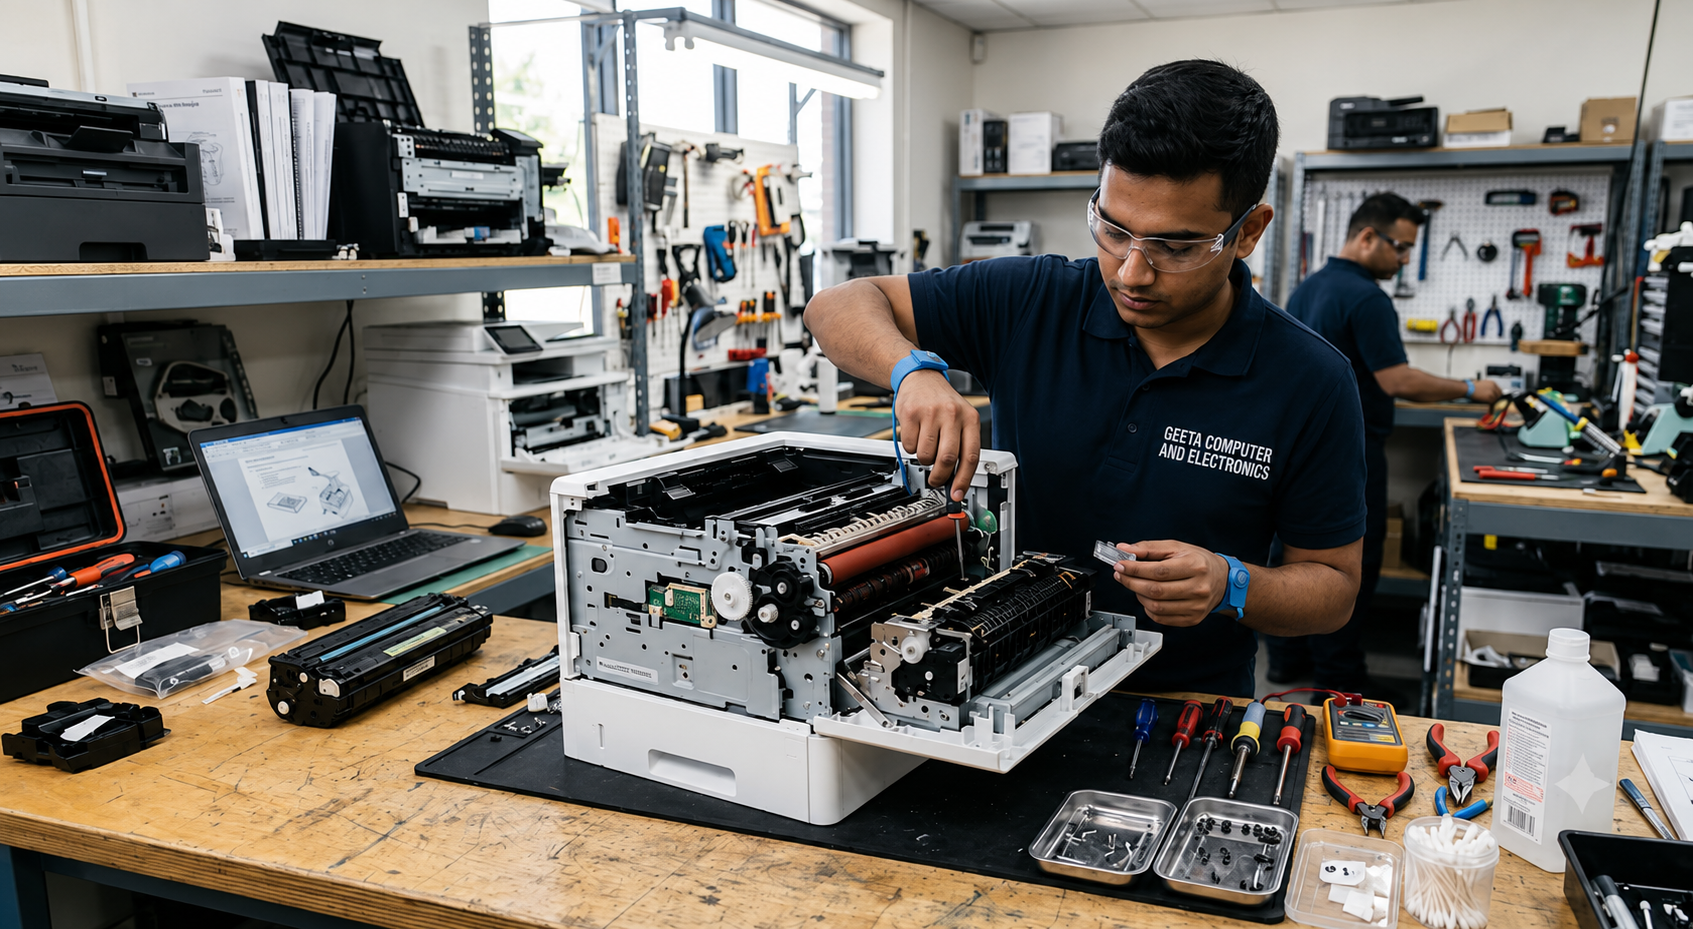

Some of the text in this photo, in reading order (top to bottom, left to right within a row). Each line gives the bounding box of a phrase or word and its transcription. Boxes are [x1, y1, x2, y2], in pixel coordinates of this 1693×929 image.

[1158, 443, 1270, 480] AND ELECTRONICS
[1164, 426, 1272, 463] GEETA COMPUTER
